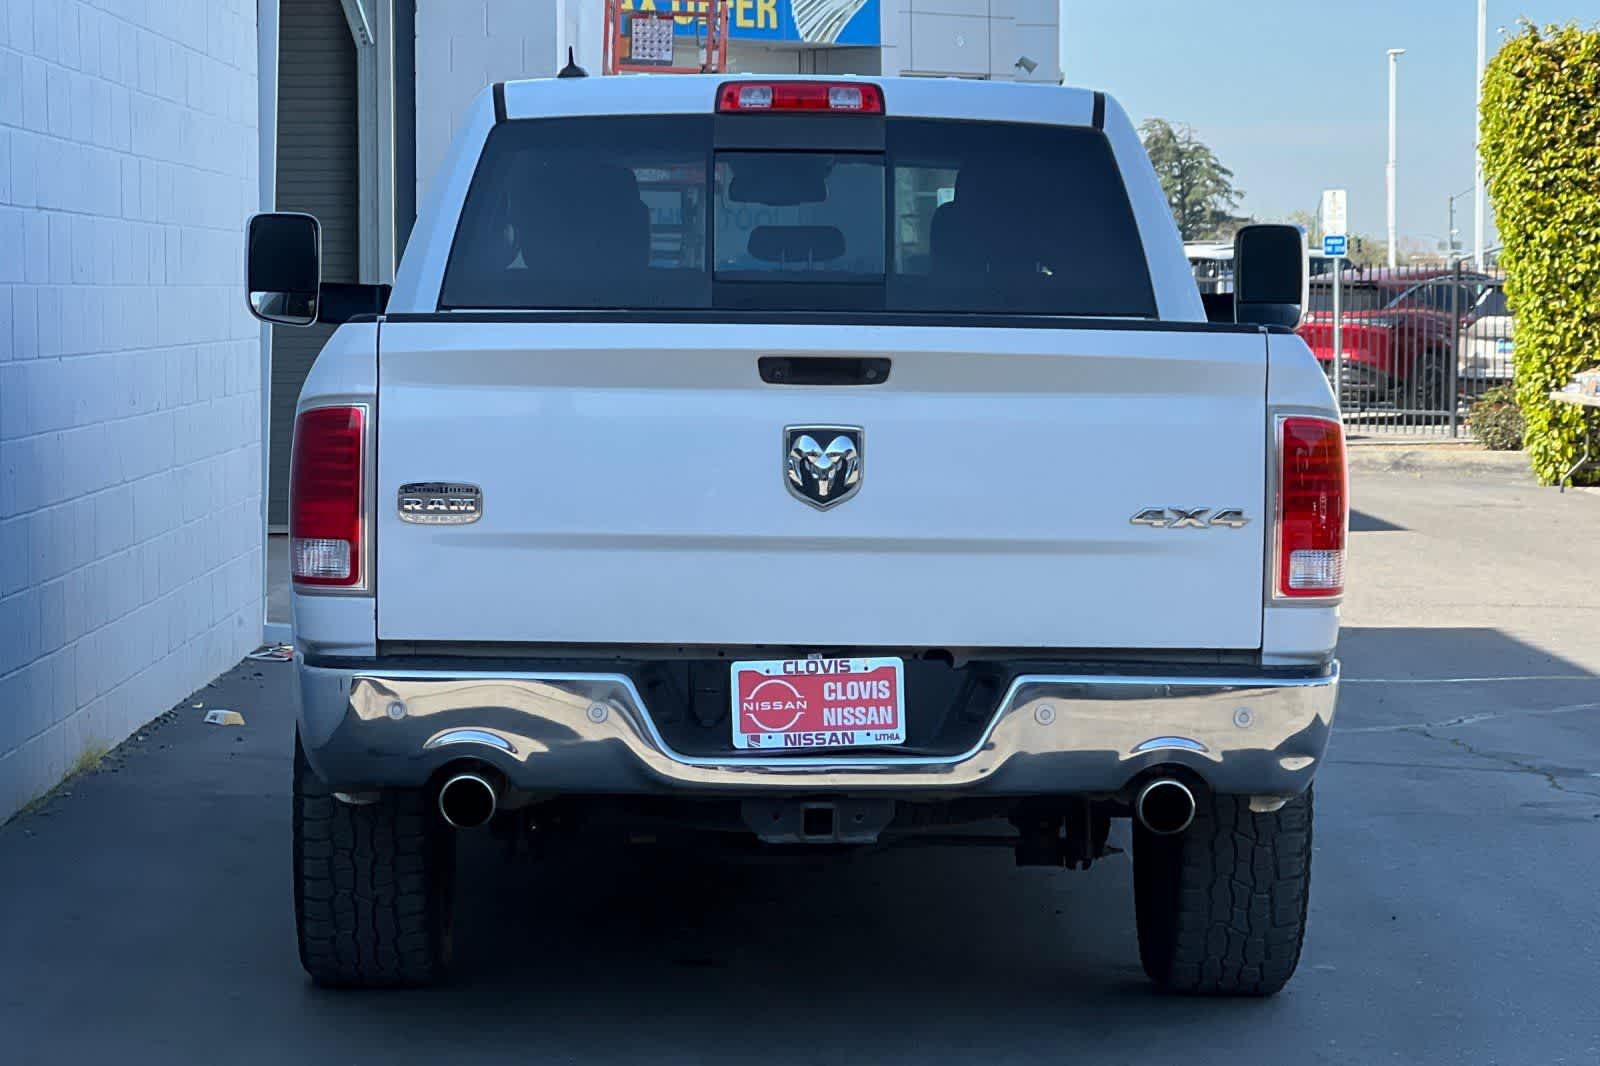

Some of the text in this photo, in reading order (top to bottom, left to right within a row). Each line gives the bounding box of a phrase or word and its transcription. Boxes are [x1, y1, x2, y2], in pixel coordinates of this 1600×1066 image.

[403, 498, 476, 511] RAM
[782, 659, 851, 675] CLOVIS
[823, 680, 890, 701] CLOVIS
[743, 700, 808, 711] NISSAN
[823, 705, 893, 727] NISSAN
[784, 731, 855, 747] NISSAN
[874, 732, 900, 742] LITHIA
